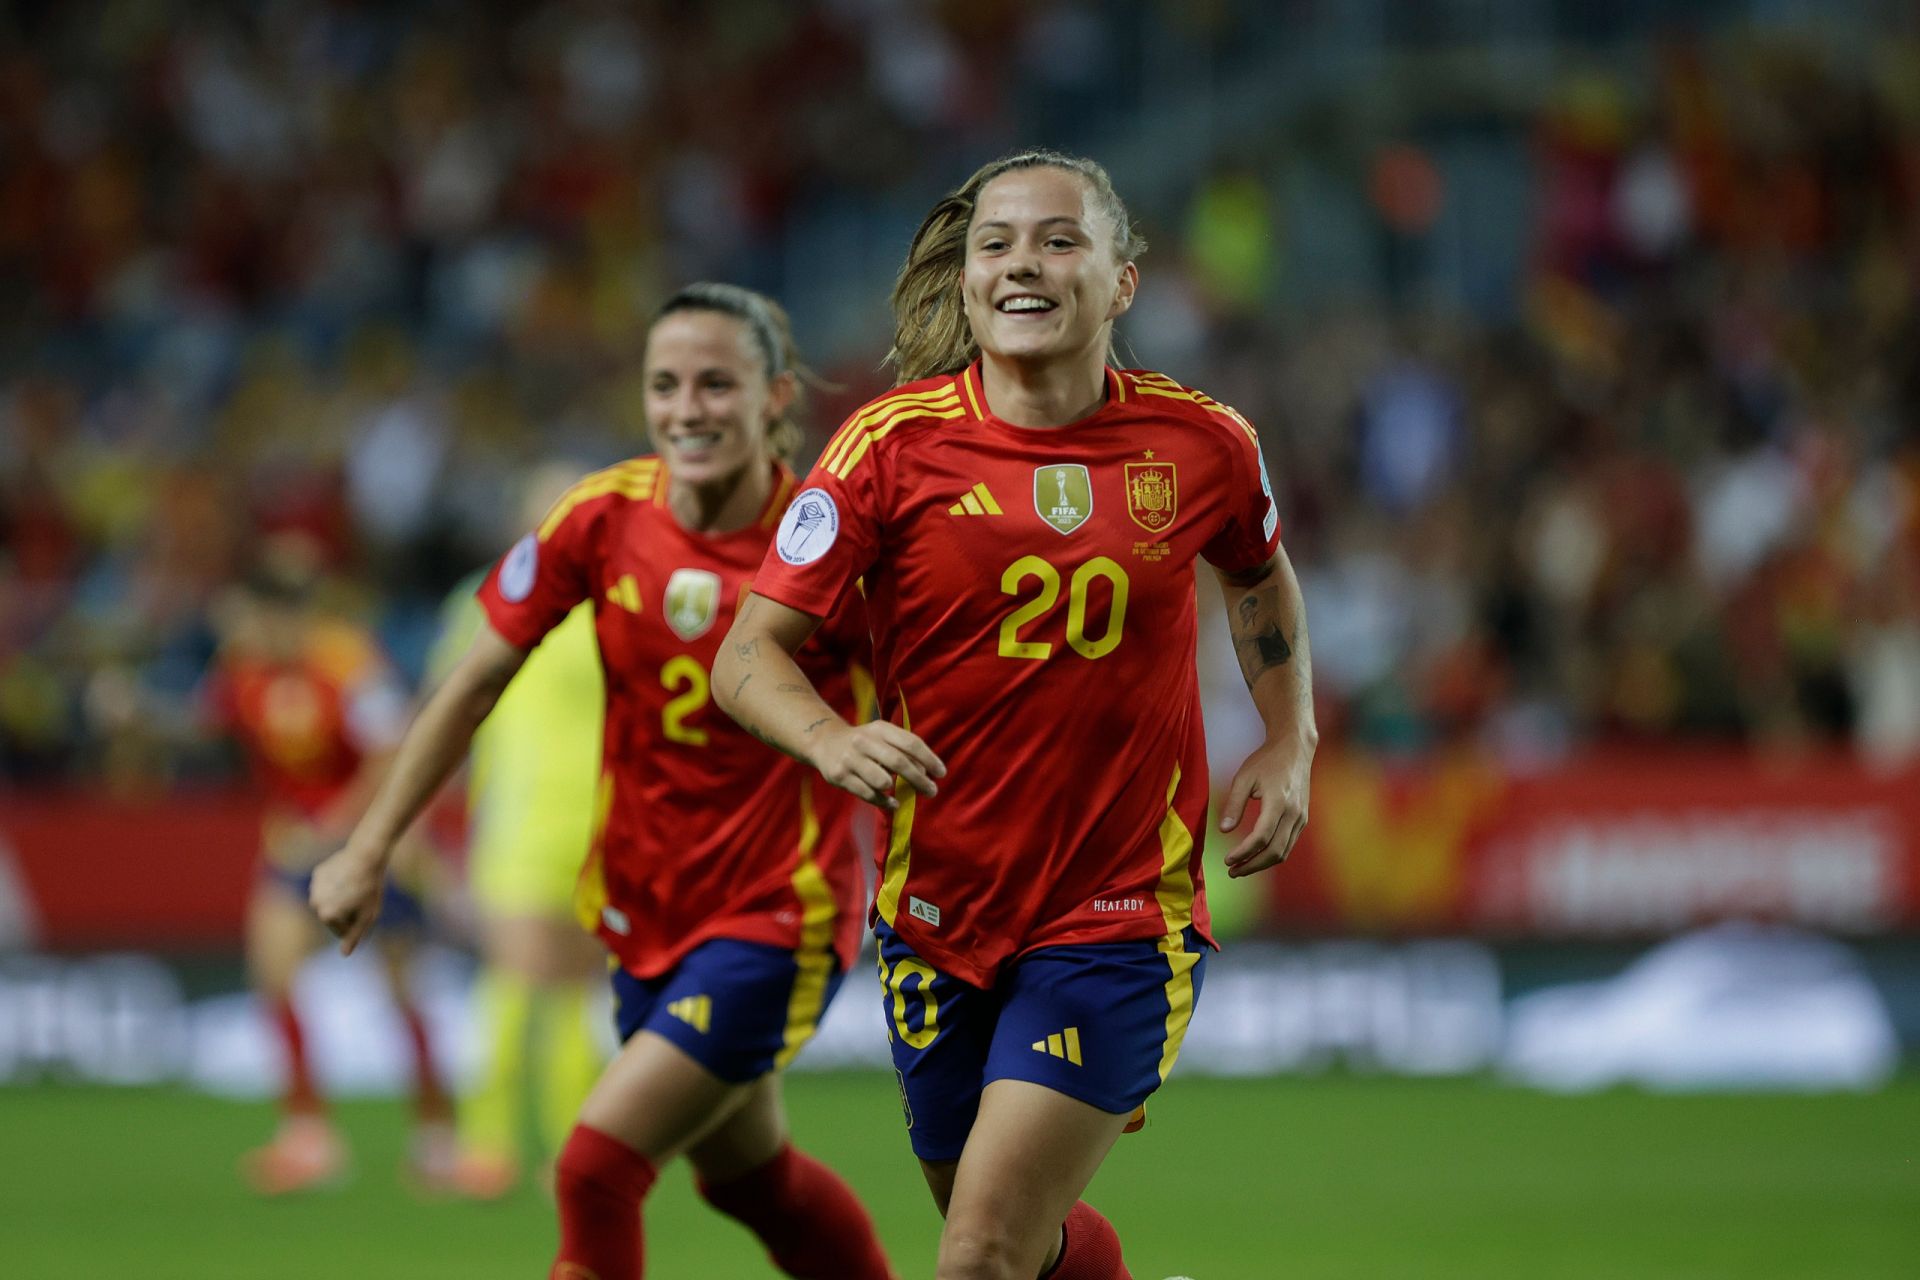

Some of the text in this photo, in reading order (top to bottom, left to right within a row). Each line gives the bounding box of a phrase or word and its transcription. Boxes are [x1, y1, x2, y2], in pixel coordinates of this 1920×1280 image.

[1051, 507, 1077, 515] FIFA
[998, 555, 1129, 660] 20
[660, 655, 711, 746] 2
[1094, 899, 1144, 912] HEAT.RDY
